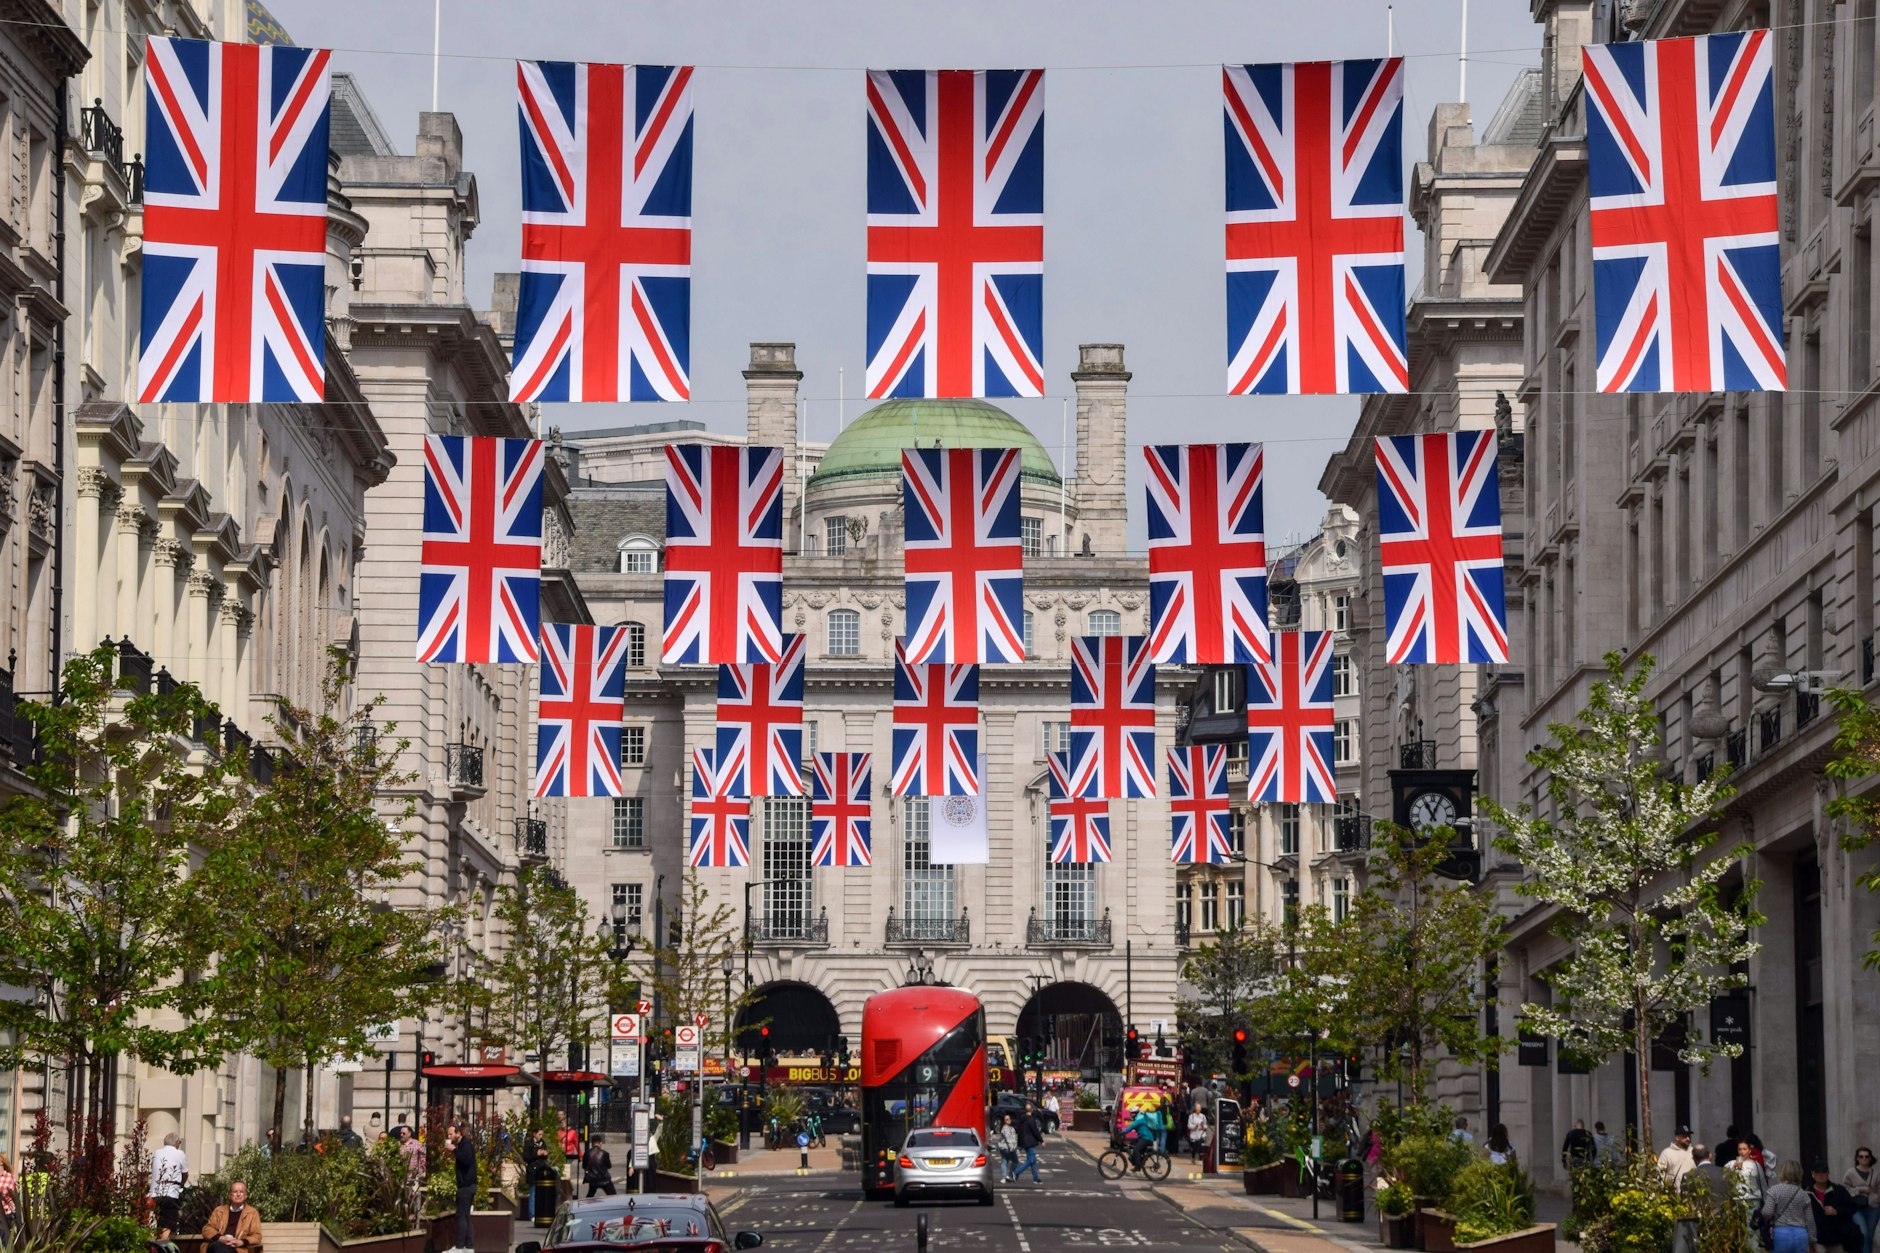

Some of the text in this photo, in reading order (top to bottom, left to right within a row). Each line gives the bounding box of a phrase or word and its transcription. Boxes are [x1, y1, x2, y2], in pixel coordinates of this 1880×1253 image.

[639, 1001, 649, 1012] Z
[698, 1016, 705, 1025] Y
[922, 1067, 932, 1081] 9
